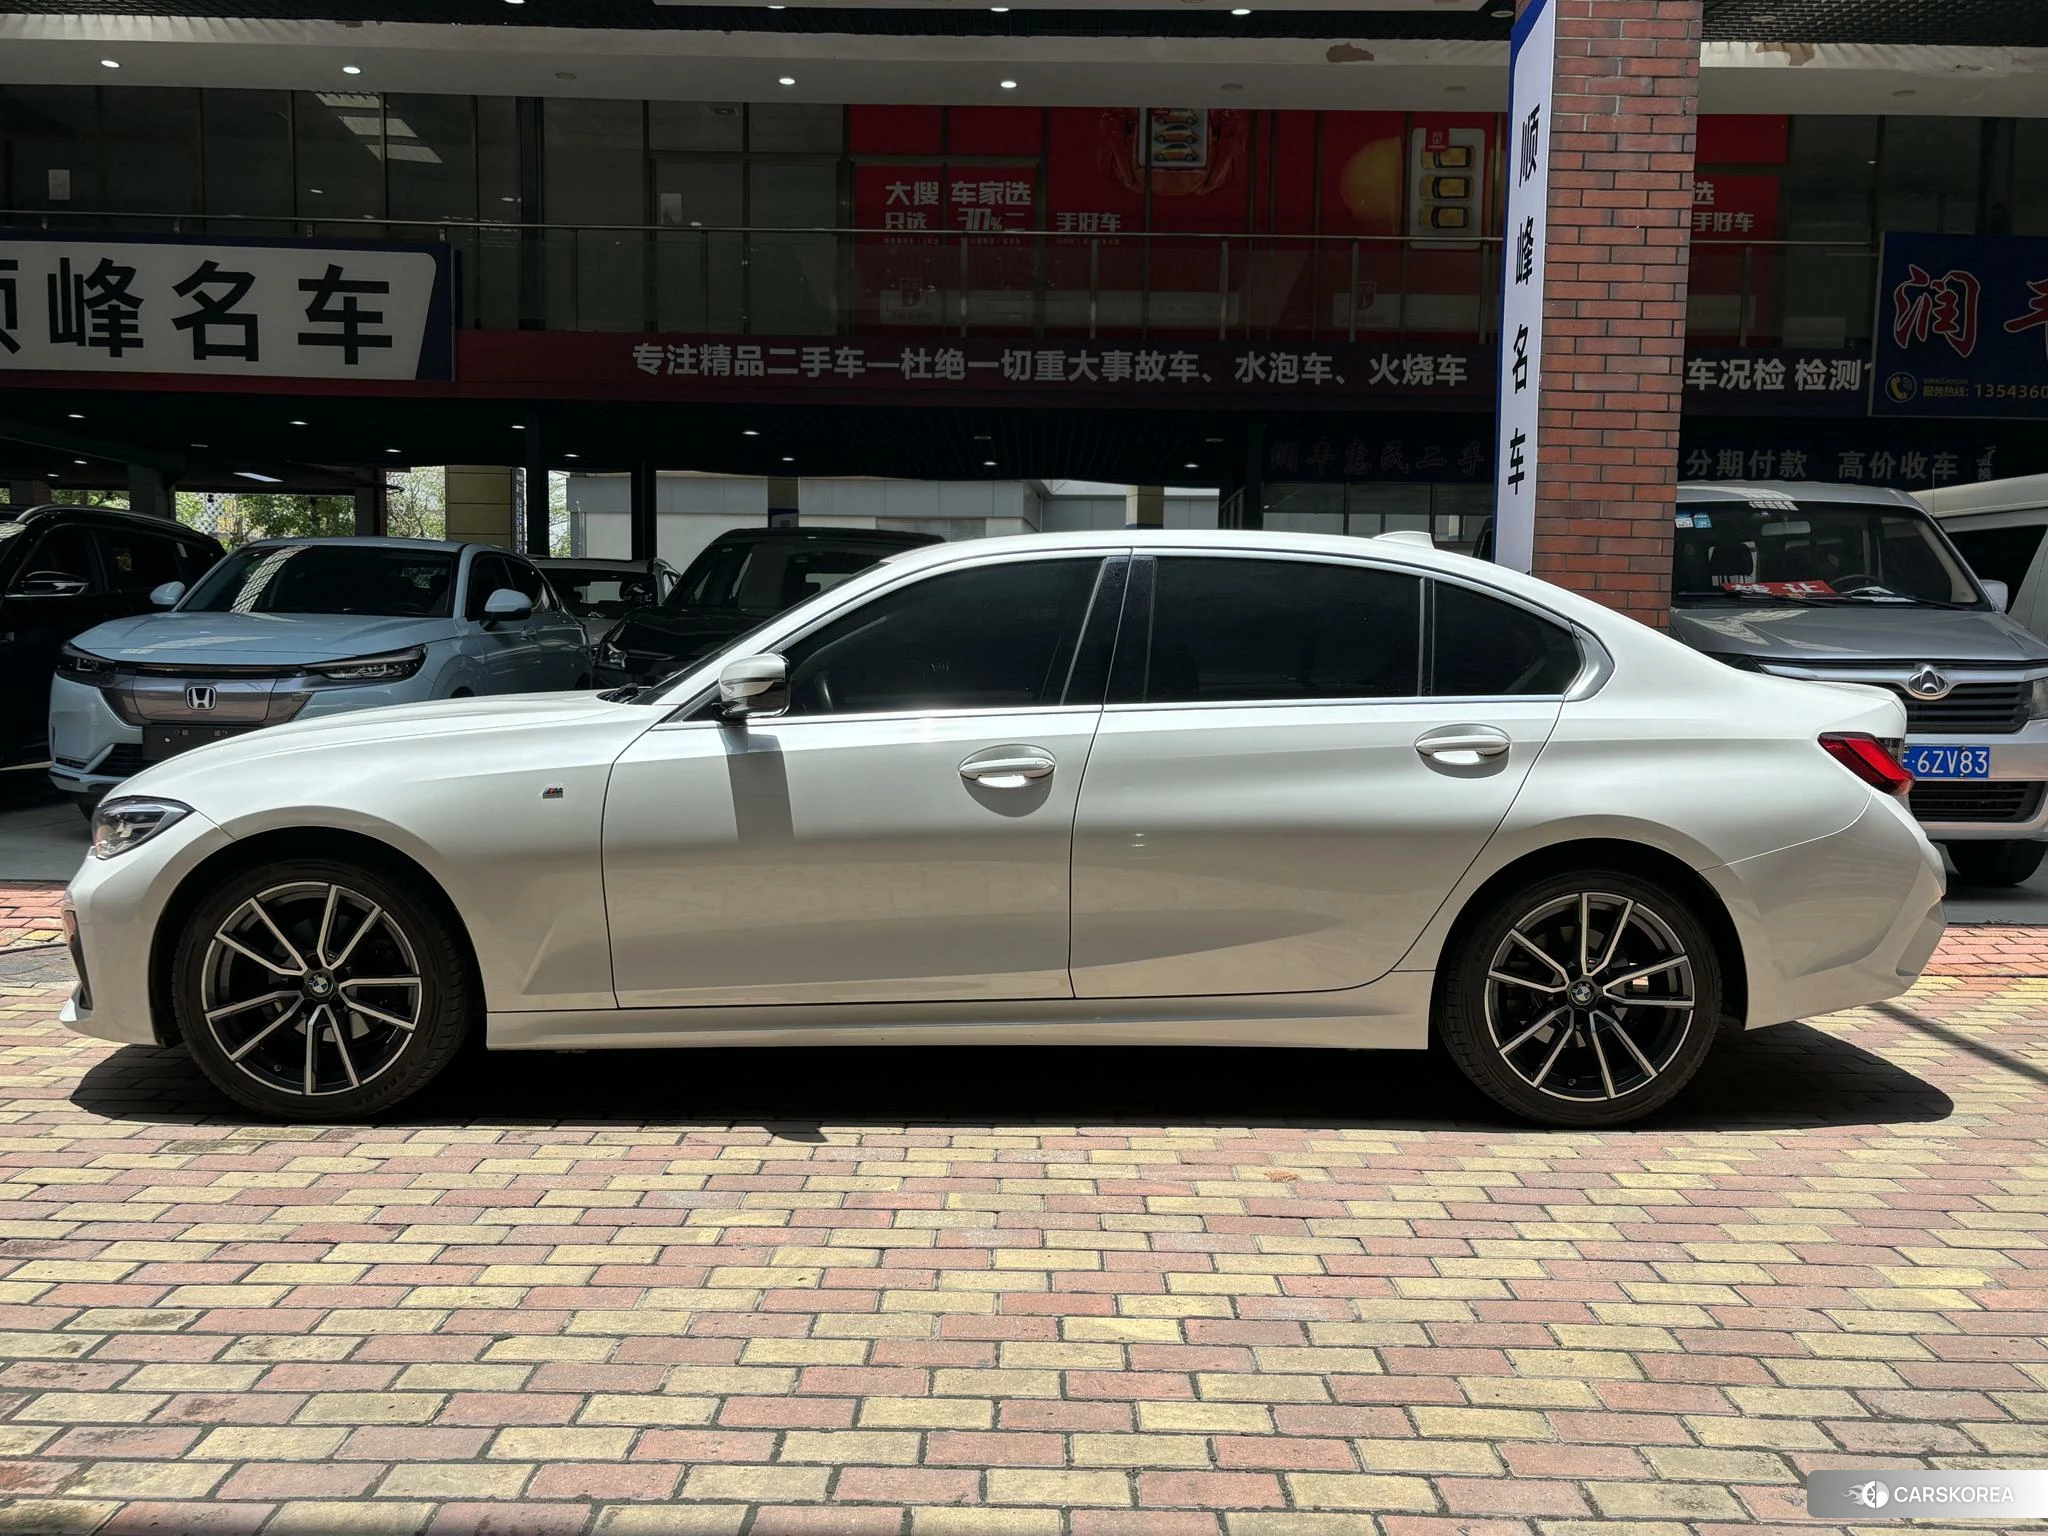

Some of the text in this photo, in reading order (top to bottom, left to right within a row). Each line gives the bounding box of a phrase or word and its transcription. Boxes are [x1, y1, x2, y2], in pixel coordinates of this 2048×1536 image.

[0, 257, 393, 365] 峰名车
[1507, 103, 1541, 495] 顺峰名车
[1685, 449, 1959, 481] 分期付款 高价收车
